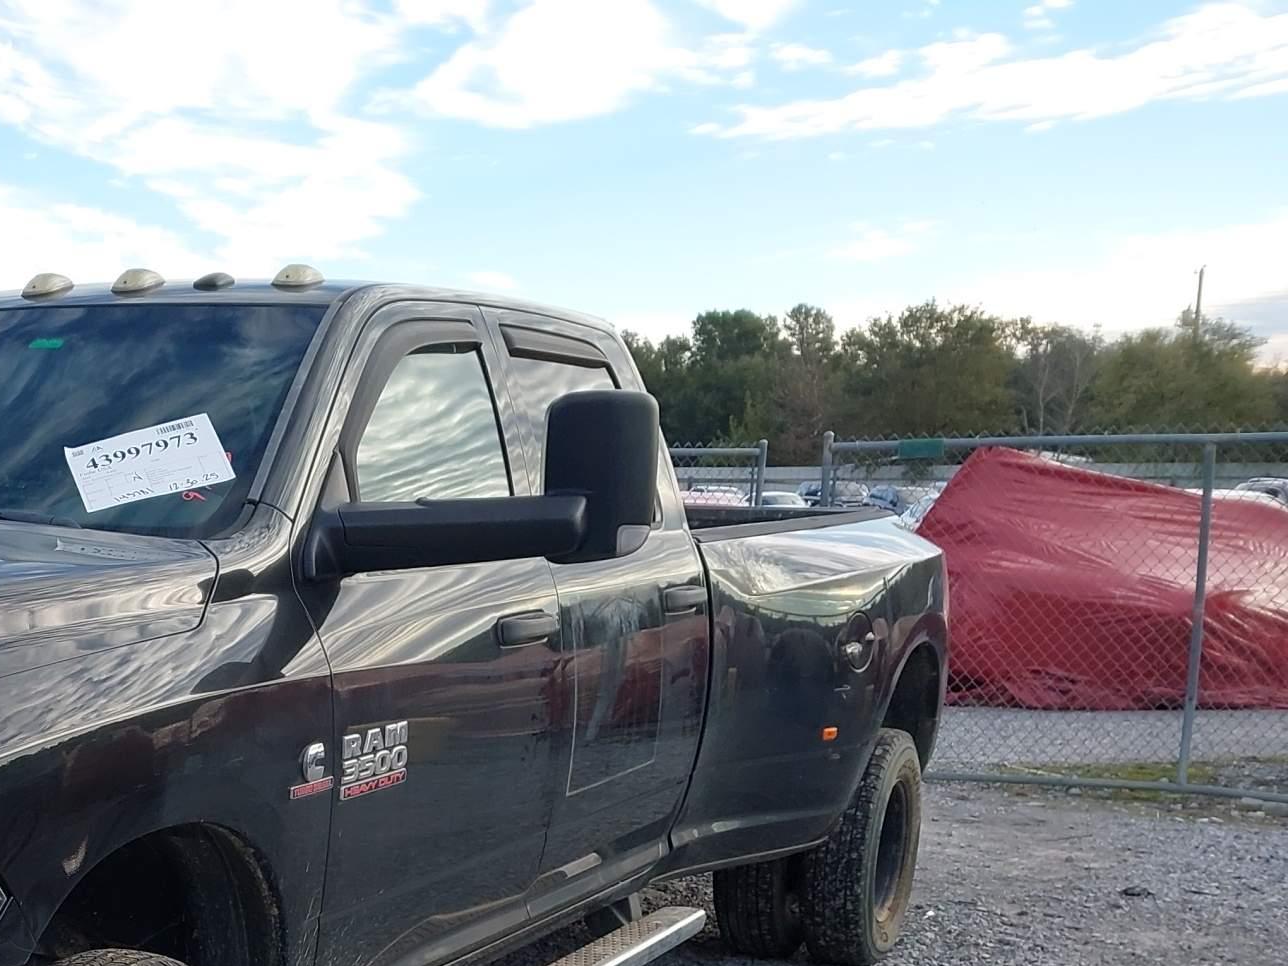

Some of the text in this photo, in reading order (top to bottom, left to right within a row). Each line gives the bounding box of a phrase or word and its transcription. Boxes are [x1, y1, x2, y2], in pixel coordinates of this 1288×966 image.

[86, 431, 198, 470] 43997973
[343, 720, 408, 759] RAM
[341, 745, 408, 784] 3500
[344, 771, 405, 798] HEAVY DUTY
